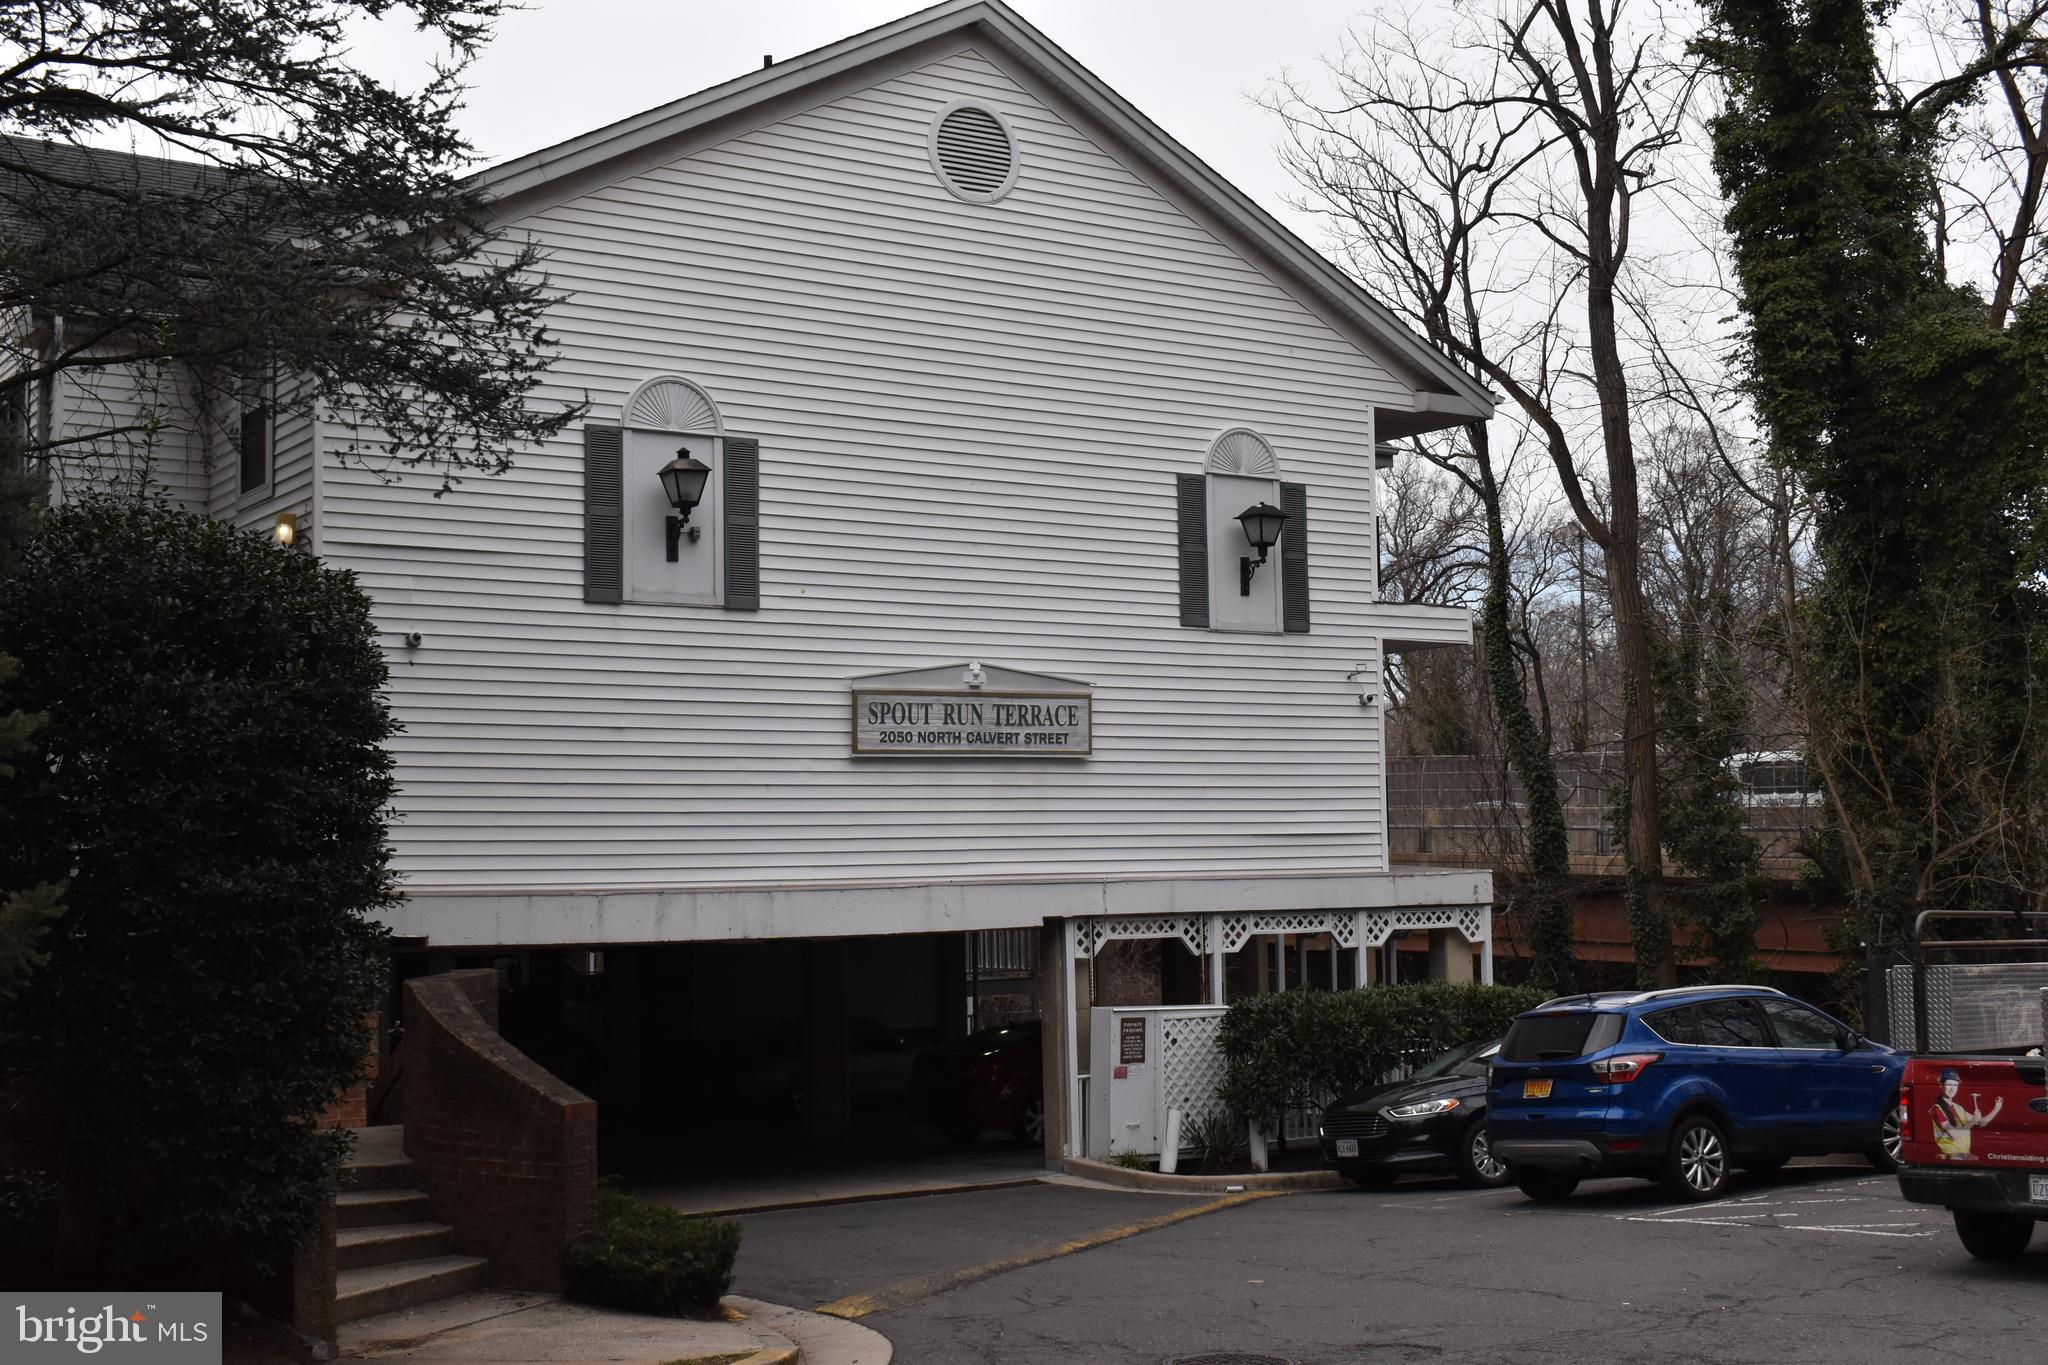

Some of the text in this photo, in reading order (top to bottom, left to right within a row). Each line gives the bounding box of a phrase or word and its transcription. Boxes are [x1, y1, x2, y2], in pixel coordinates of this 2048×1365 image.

[868, 701, 1079, 727] SPOUT RUN TERRACE
[879, 731, 1069, 745] 2050 NORTH CALVERT STREET
